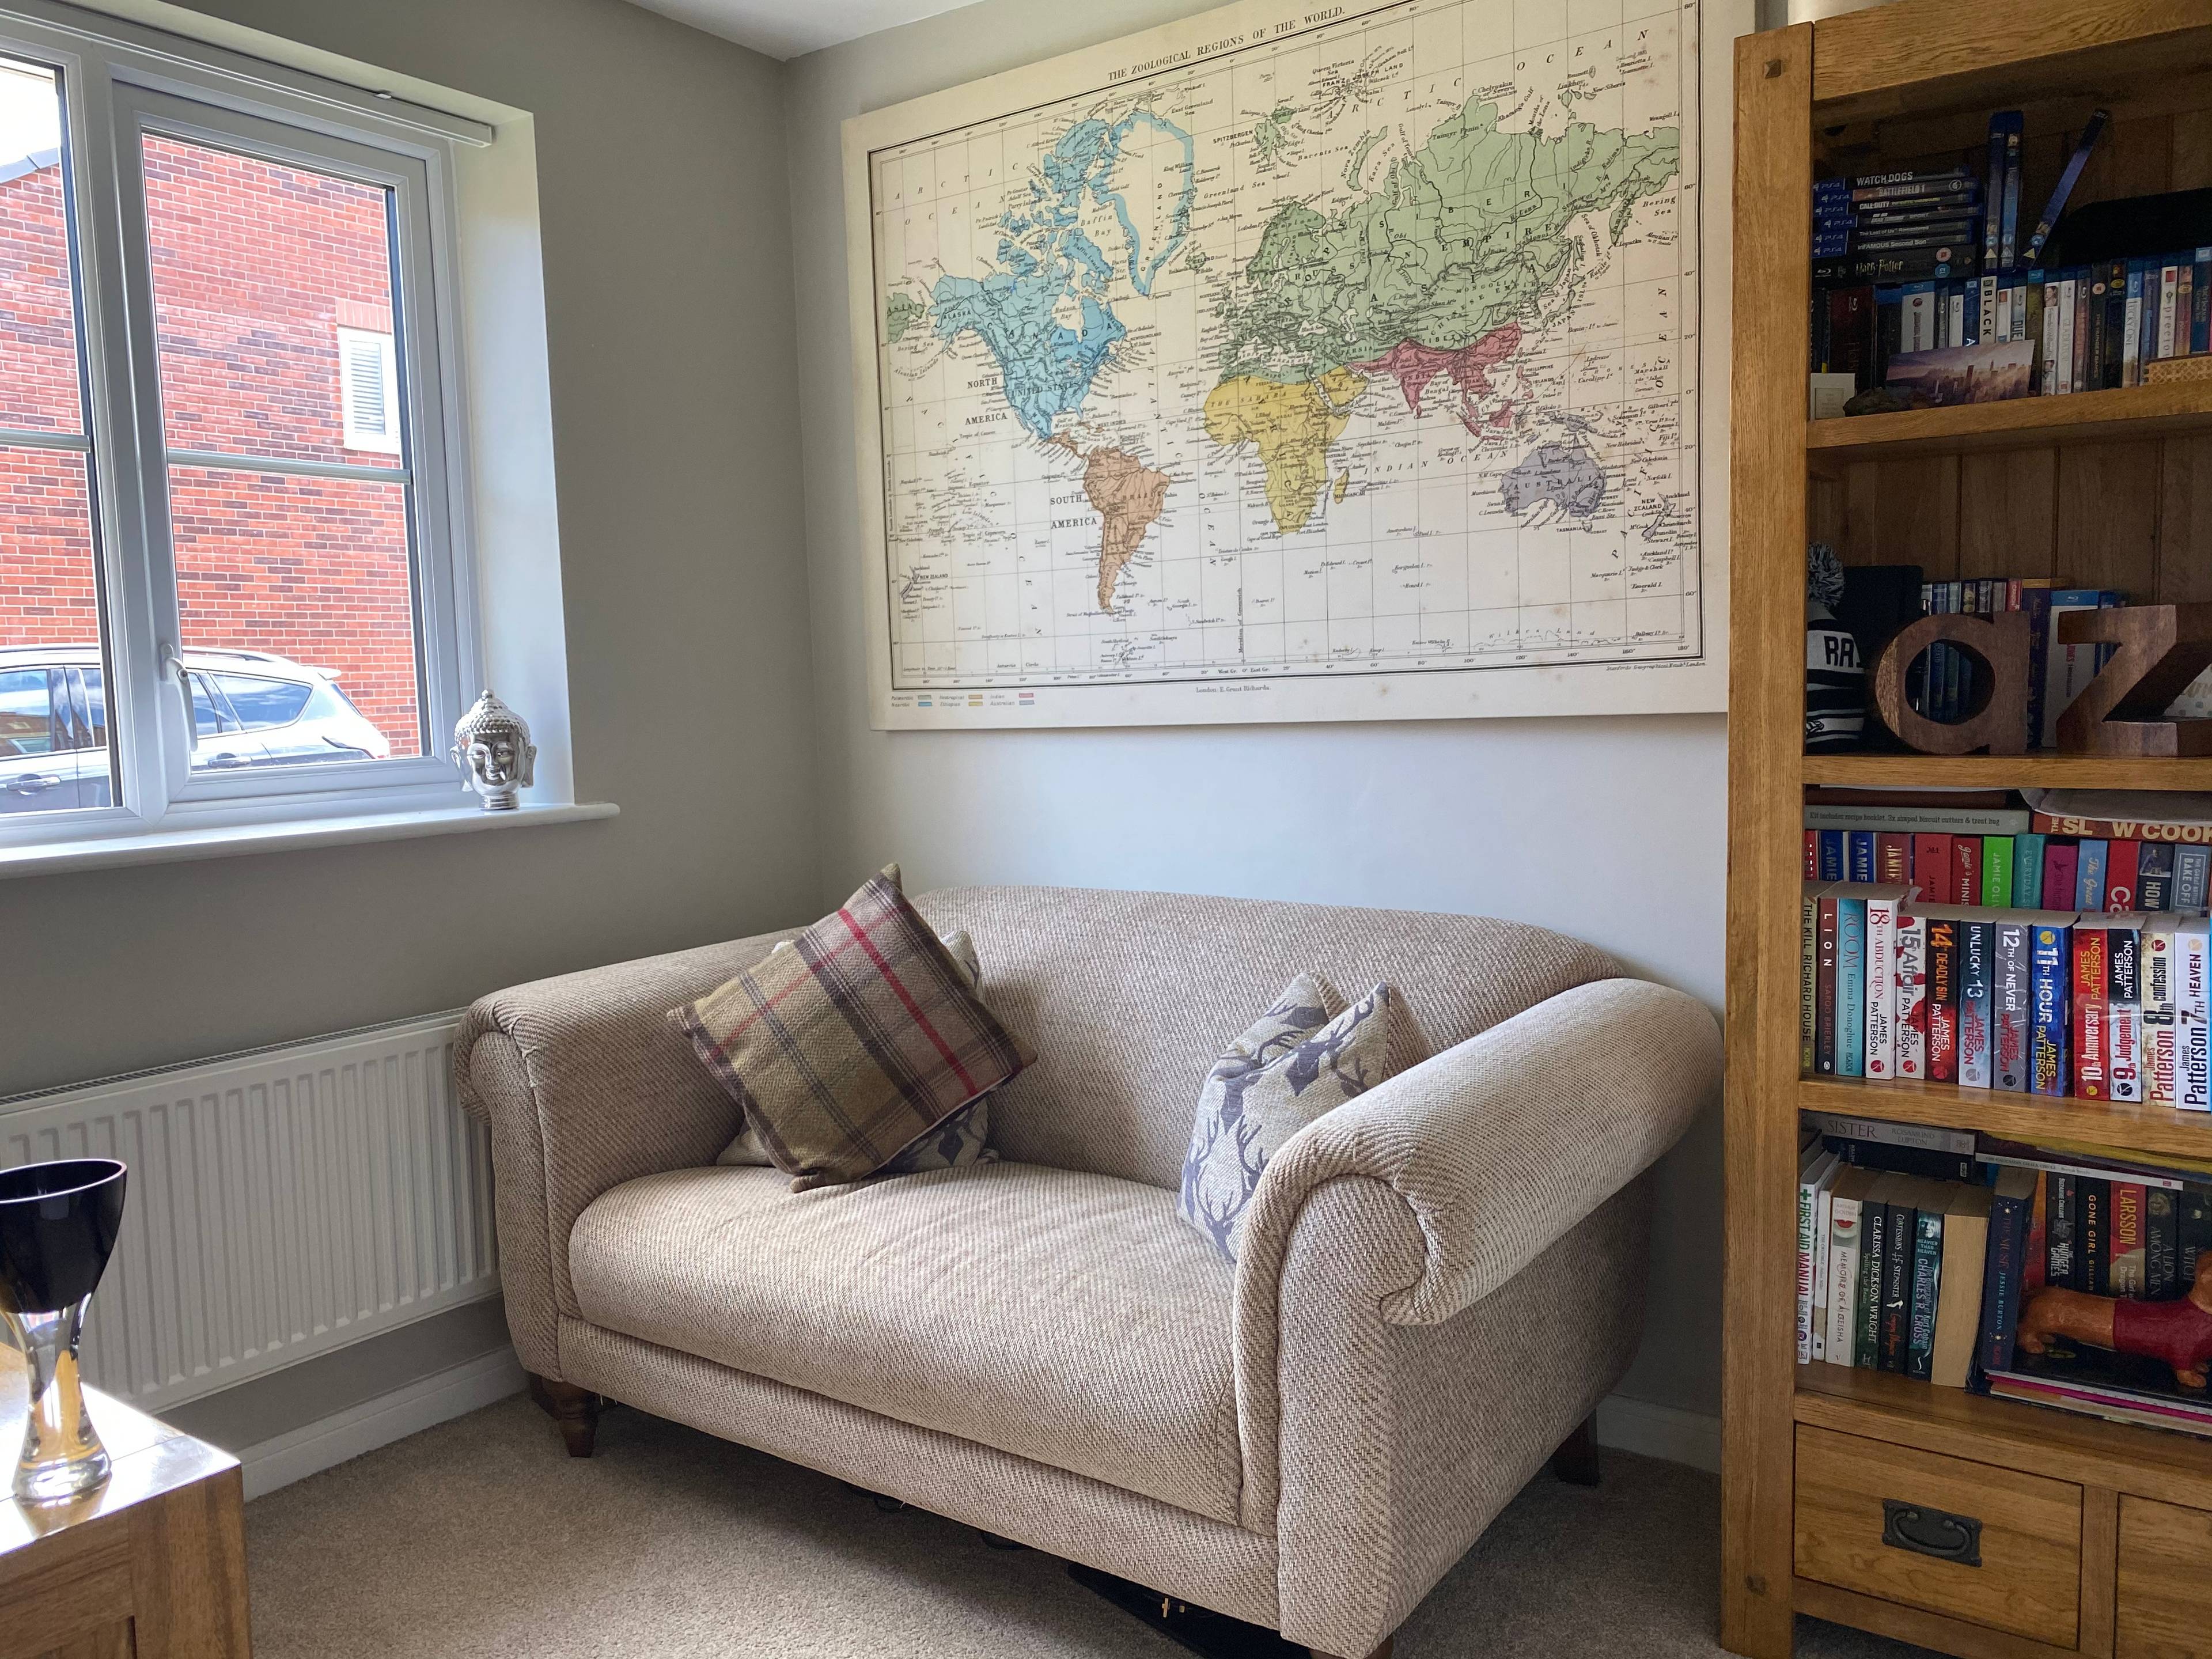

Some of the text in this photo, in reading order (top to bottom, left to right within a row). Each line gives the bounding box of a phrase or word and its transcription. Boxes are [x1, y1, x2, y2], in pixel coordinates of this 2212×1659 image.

[1108, 69, 1127, 81] THE
[1131, 50, 1191, 75] ZOOLOGICAL
[1197, 35, 1244, 56] REGIONS
[1253, 28, 1266, 40] OF
[1274, 20, 1296, 34] THE
[1213, 130, 1253, 143] SPITZBERGEN
[1879, 185, 1919, 196] BATTLEFIELD
[1983, 290, 1992, 335] BLACK
[967, 377, 997, 388] NORTH
[965, 413, 1007, 425] AMERICA
[1050, 495, 1082, 505] SOUTH
[1051, 517, 1097, 529] AMERICA
[1824, 635, 1862, 668] RA
[1820, 812, 1843, 820] includes
[1897, 815, 1918, 823] shaped
[1919, 815, 1940, 823] biscuit
[1988, 818, 2000, 826] bag
[1825, 839, 1838, 881] JAMIE
[1856, 840, 1868, 882] JAMIE
[1992, 853, 2001, 882] JAMIE
[2087, 857, 2100, 875] The
[2145, 881, 2161, 908] HOW
[2181, 857, 2194, 904] BAKE OFF
[1804, 904, 1813, 925] THE
[1804, 928, 1813, 949] KILL
[1824, 913, 1832, 966] LION
[1843, 913, 1860, 968] ROOM
[1803, 955, 1812, 1002] RICHARD
[1870, 939, 1885, 1000] ABDUCTION
[1902, 952, 1919, 996] Affair
[1936, 953, 1948, 983] DEADLY
[1967, 926, 1983, 998] UNLUCKY 13
[2008, 960, 2014, 972] OF
[2080, 951, 2090, 986] JAMES
[2092, 938, 2100, 999] PATTERSON
[2115, 952, 2123, 986] JAMES
[2124, 941, 2133, 999] PATTERSON
[2150, 957, 2166, 1001] confession
[2189, 954, 2202, 997] HEAVEN
[1844, 974, 1855, 1048] Emma Donoghue
[1936, 984, 1948, 1001] SIN
[2005, 974, 2016, 1011] NEVER
[2039, 978, 2053, 1023] HOUR
[1802, 1006, 1811, 1042] HOUSE
[1823, 1016, 1831, 1055] BRIERLEY
[1870, 1002, 1878, 1055] PATTERSON
[1901, 998, 1911, 1058] PATTERSON
[1931, 1003, 1941, 1062] PATTERSON
[1941, 1017, 1950, 1051] JAMES
[1964, 1001, 1975, 1065] PATTERSON
[1974, 1015, 1984, 1052] JAMES
[2000, 1014, 2010, 1071] PATTERSON
[2082, 1003, 2102, 1060] Anniversary
[2115, 1009, 2131, 1062] Judgement
[2009, 1027, 2019, 1060] JAMES
[2036, 1025, 2046, 1089] PATTERSON
[2046, 1040, 2056, 1078] JAMES
[2143, 1048, 2156, 1070] James
[2179, 1046, 2190, 1071] James
[2150, 1031, 2174, 1101] Patterson
[2184, 1028, 2207, 1105] Patterson
[1827, 1119, 1878, 1139] SISTER
[1891, 1128, 1935, 1139] ROSAMUND
[1801, 1202, 1812, 1228] FIRST
[2087, 1194, 2096, 1255] GONE GIRL
[2119, 1189, 2137, 1245] LARSSON
[1799, 1229, 1809, 1250] AID
[2150, 1226, 2162, 1269] AMONG
[2050, 1247, 2060, 1277] GAMES
[2057, 1242, 2070, 1275] HUNGER
[1868, 1216, 1883, 1343] CLARISSA DICKSON WRIGHT
[1915, 1258, 1929, 1300] CHARLES
[1996, 1271, 2006, 1331] JESSIE BURTON
[1837, 1313, 1845, 1343] GEISHA
[1913, 1314, 1923, 1344] CROSS
[1921, 1328, 1930, 1350] Cobain
[1922, 1315, 1931, 1328] Kurt
